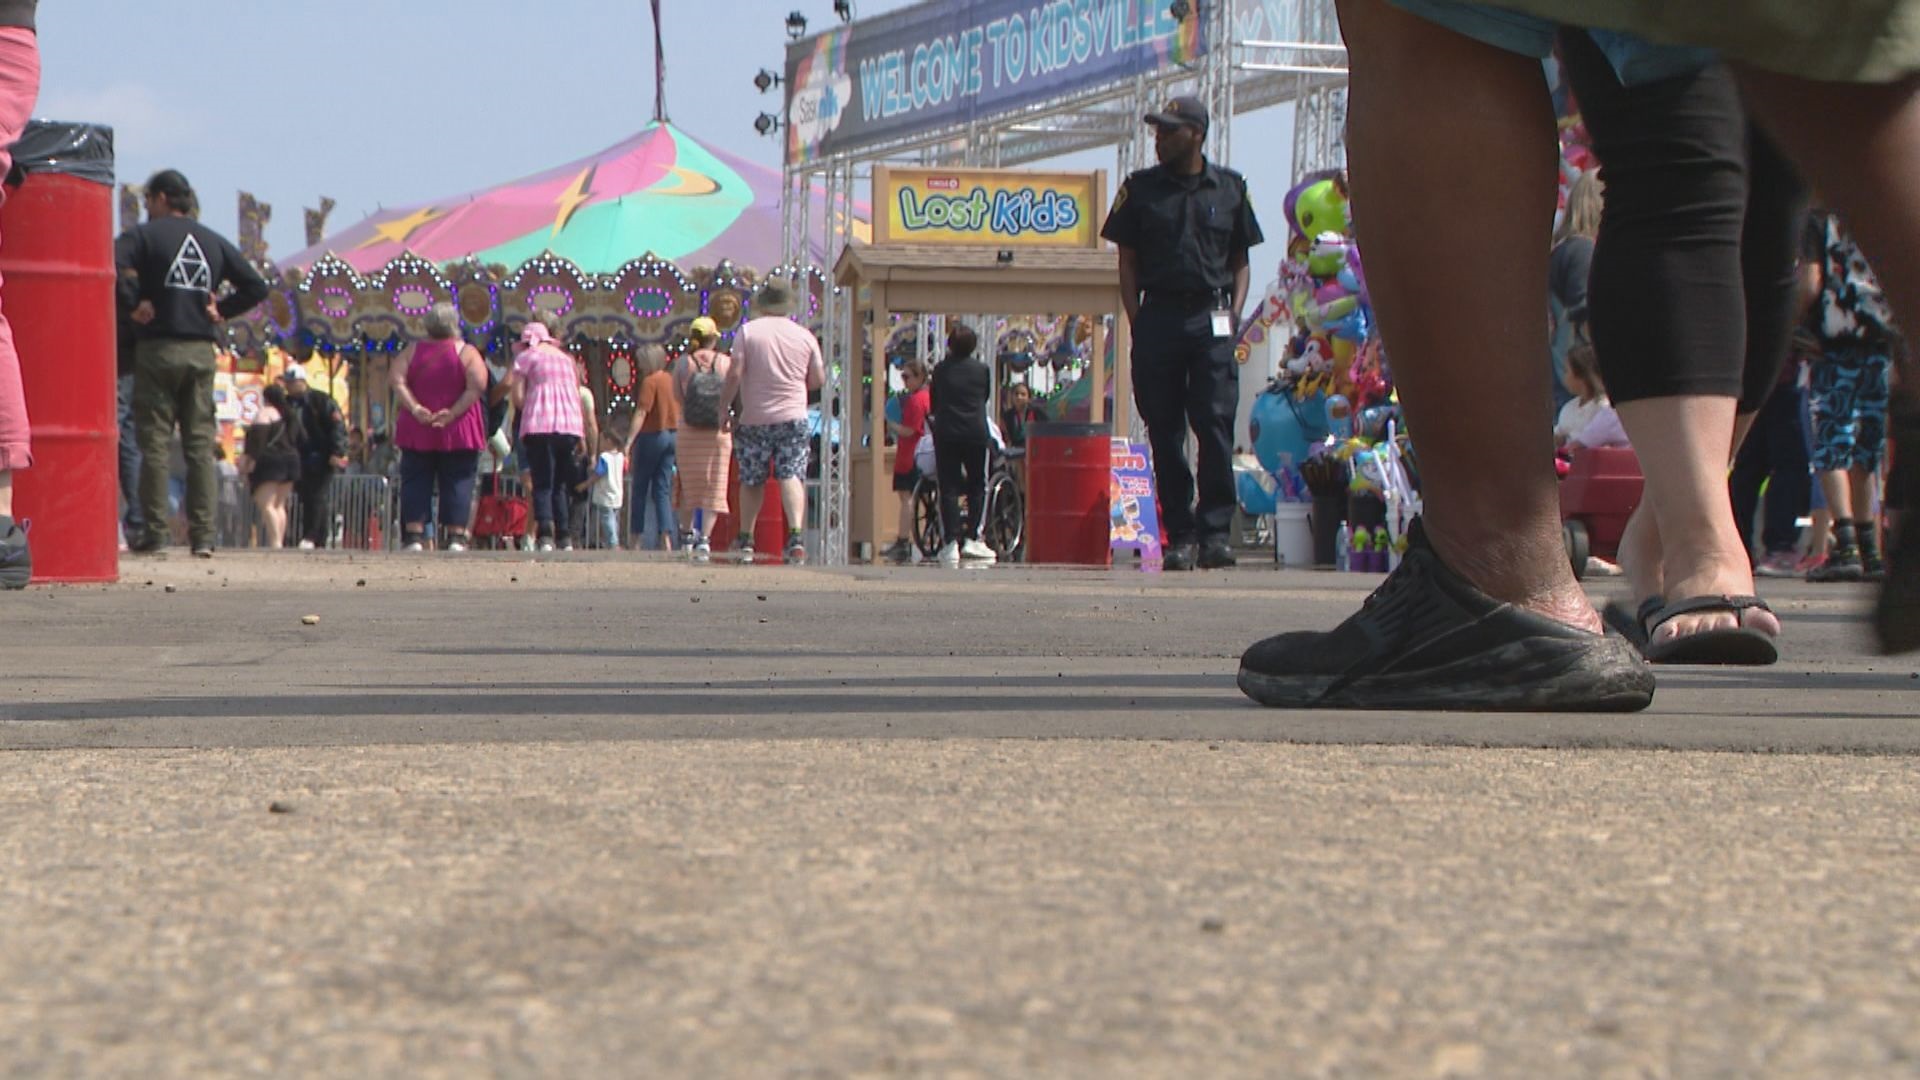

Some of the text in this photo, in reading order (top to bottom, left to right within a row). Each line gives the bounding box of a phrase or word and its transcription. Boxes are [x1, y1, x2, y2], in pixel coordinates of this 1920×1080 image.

[860, 26, 983, 121] WELCOME
[986, 13, 1028, 88] TO
[1030, 0, 1180, 76] KIDSVILLE
[900, 187, 1079, 235] Lost Kids
